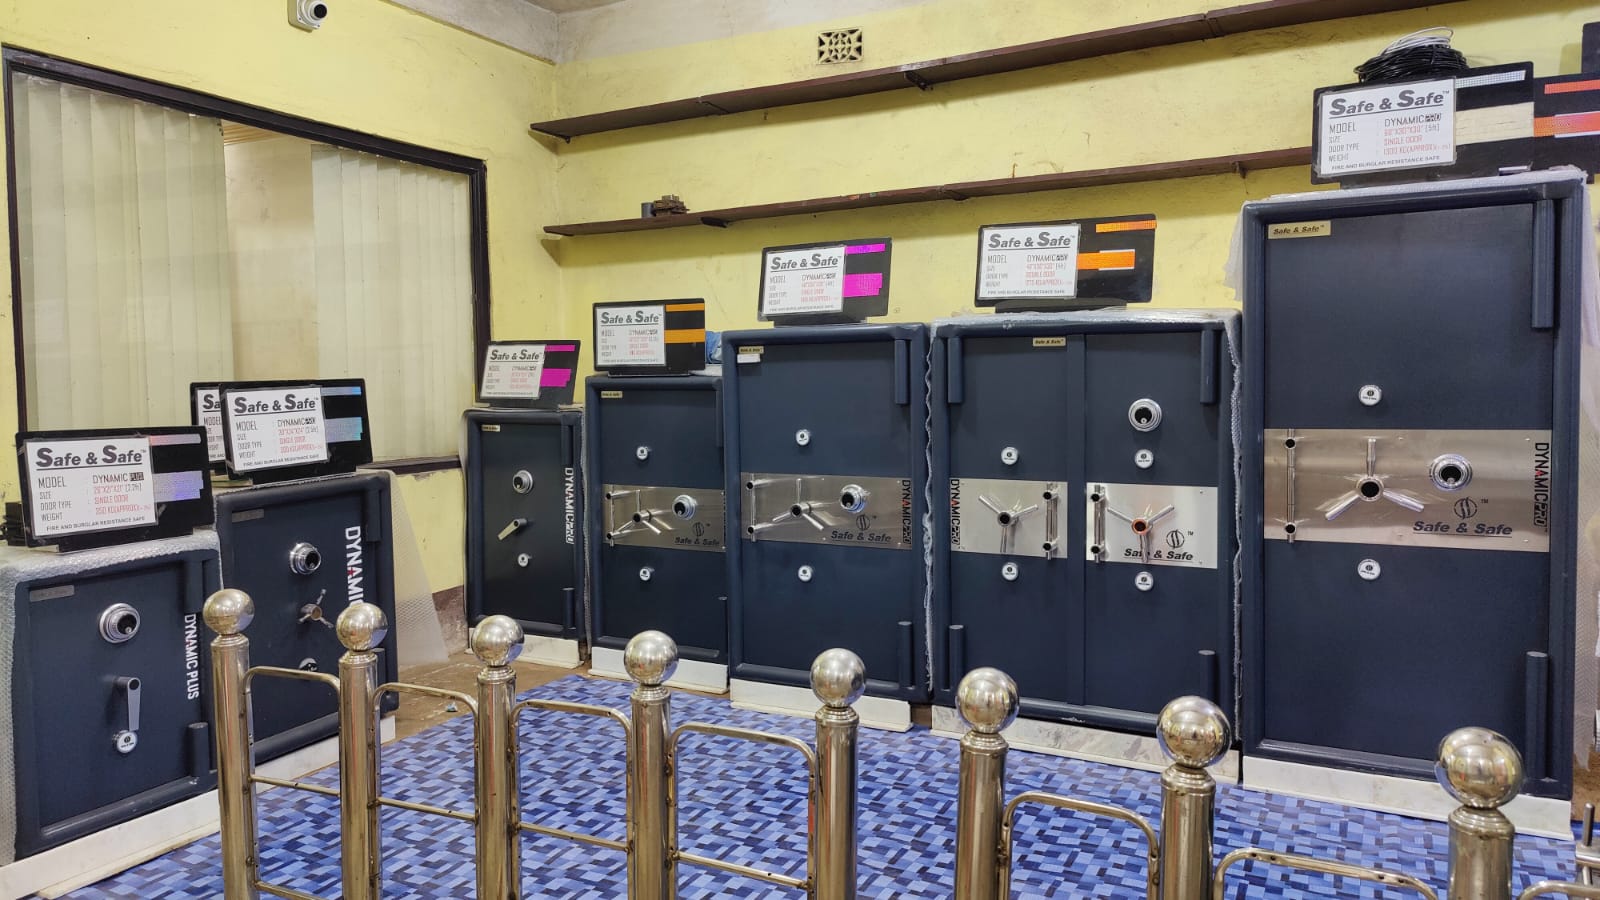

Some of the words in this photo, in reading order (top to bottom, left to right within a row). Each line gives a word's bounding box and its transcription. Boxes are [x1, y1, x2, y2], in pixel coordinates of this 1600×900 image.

[1329, 98, 1374, 116] Safe
[1379, 97, 1392, 111] &
[1397, 89, 1444, 108] Safe
[1329, 122, 1357, 135] MODEL
[1328, 145, 1345, 154] DOOR
[1345, 143, 1360, 152] TYPE
[1345, 162, 1358, 170] AND
[988, 233, 1021, 249] Safe
[1024, 236, 1035, 248] &
[1037, 231, 1072, 247] Safe
[770, 256, 798, 270] Safe
[800, 258, 808, 268] &
[810, 253, 839, 267] Safe
[601, 311, 624, 324] Safe
[625, 314, 633, 324] &
[635, 310, 659, 323] Safe
[490, 349, 510, 361] Safe
[511, 352, 518, 360] &
[519, 349, 540, 360] Safe
[234, 396, 269, 414] Safe
[272, 400, 281, 411] &
[285, 394, 316, 410] Safe
[36, 447, 81, 467] Safe
[85, 452, 98, 465] &
[102, 445, 142, 464] Safe
[38, 476, 67, 489] MODEL
[93, 473, 128, 485] DYNAMIC
[40, 502, 57, 511] DOOR
[58, 501, 72, 509] TYPE
[46, 523, 59, 531] FIRE
[1413, 521, 1450, 533] Safe
[1456, 522, 1468, 533] &
[1474, 523, 1512, 535] Safe
[831, 530, 854, 540] Safe
[857, 530, 865, 541] &
[868, 532, 892, 543] Safe
[1154, 550, 1162, 559] &
[1166, 550, 1194, 561] Safe
[184, 613, 199, 670] DYNAMIC
[186, 670, 200, 700] PLUS
